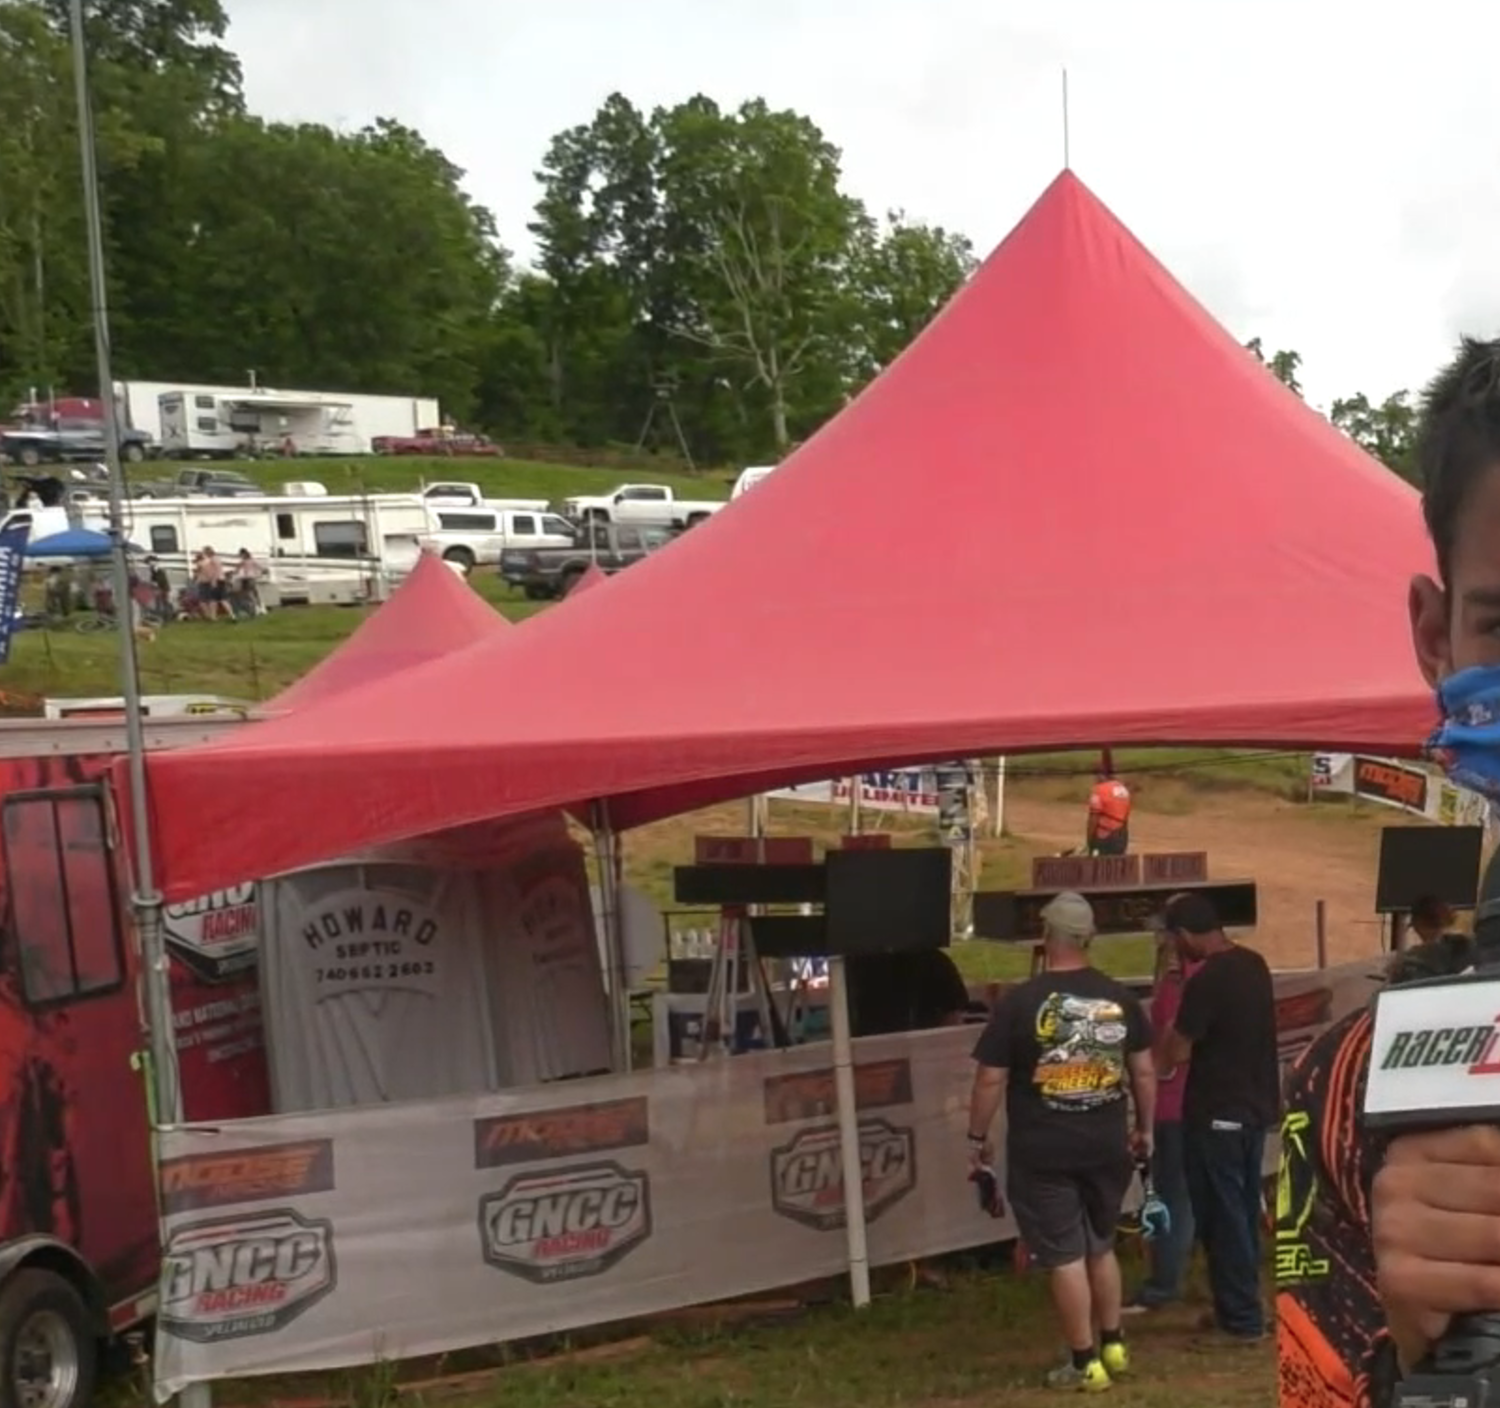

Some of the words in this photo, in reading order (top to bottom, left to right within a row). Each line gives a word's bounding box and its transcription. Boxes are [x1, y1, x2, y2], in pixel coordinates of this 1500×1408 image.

[201, 904, 258, 942] RACIN
[302, 904, 438, 949] HOWARD
[336, 941, 401, 959] SEPTIC
[492, 1181, 639, 1246] GNCC
[163, 1231, 320, 1306] GNCC
[193, 1281, 288, 1314] RACING
